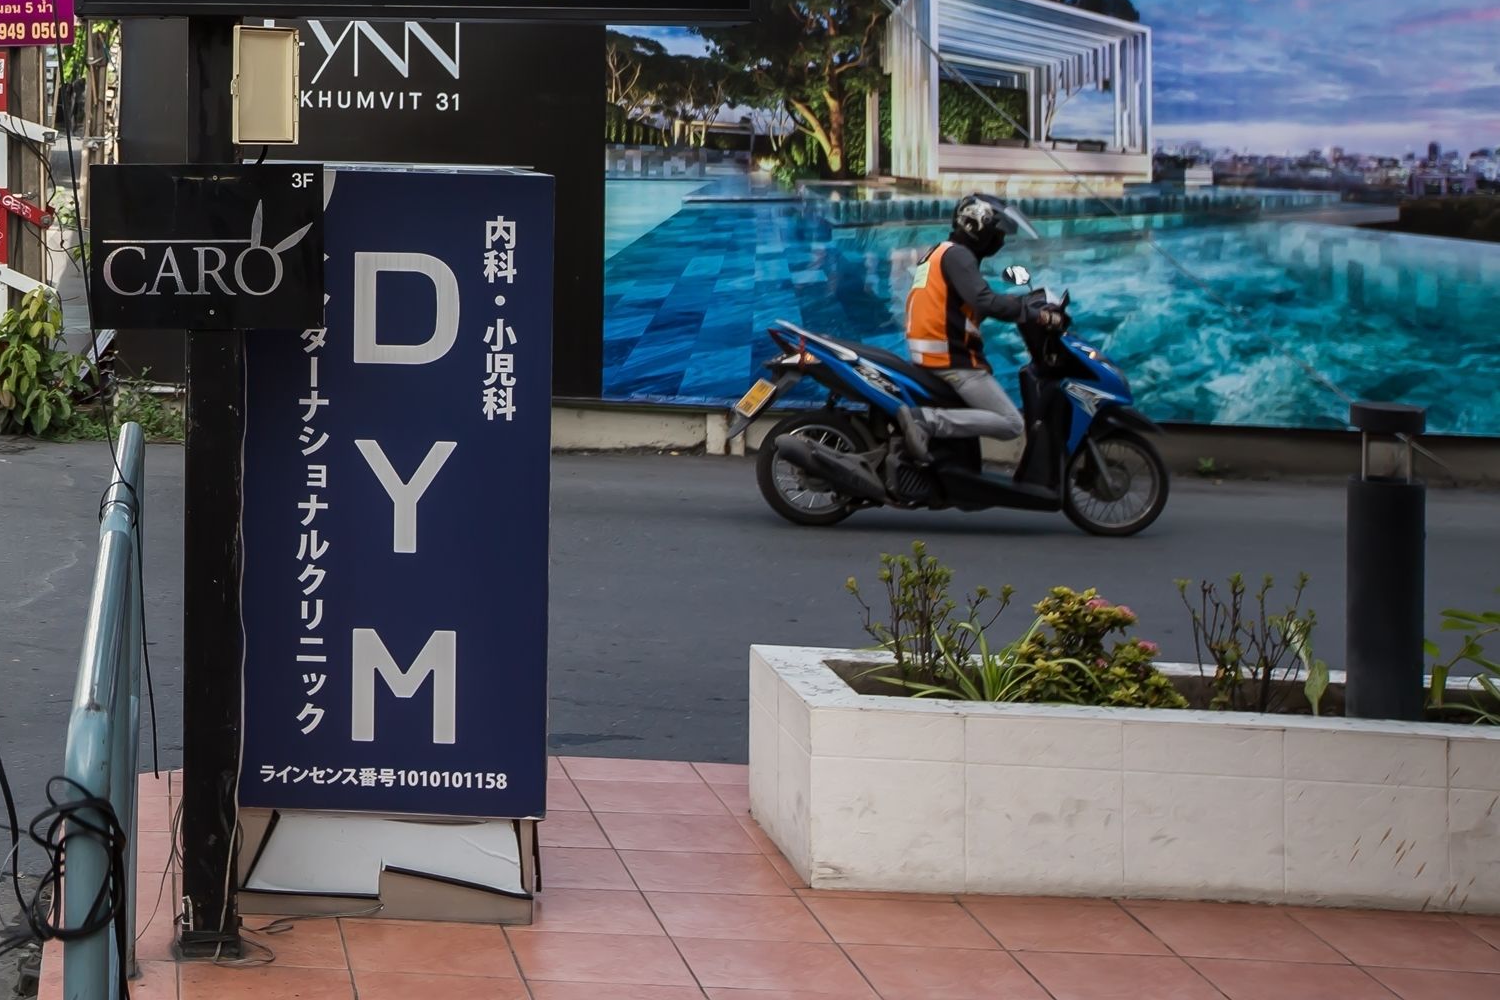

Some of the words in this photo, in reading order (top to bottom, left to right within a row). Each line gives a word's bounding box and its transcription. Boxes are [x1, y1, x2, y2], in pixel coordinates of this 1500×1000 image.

[25, 2, 33, 13] 5
[264, 20, 460, 84] YNN
[301, 90, 423, 110] KHUMVIT
[436, 92, 460, 111] 31
[291, 173, 314, 188] 3F
[103, 246, 283, 296] CARO
[483, 215, 518, 421] 内科・小児科
[296, 253, 331, 735] ターナショナルクリニック
[260, 765, 508, 790] ラインセンス番号1010101158
